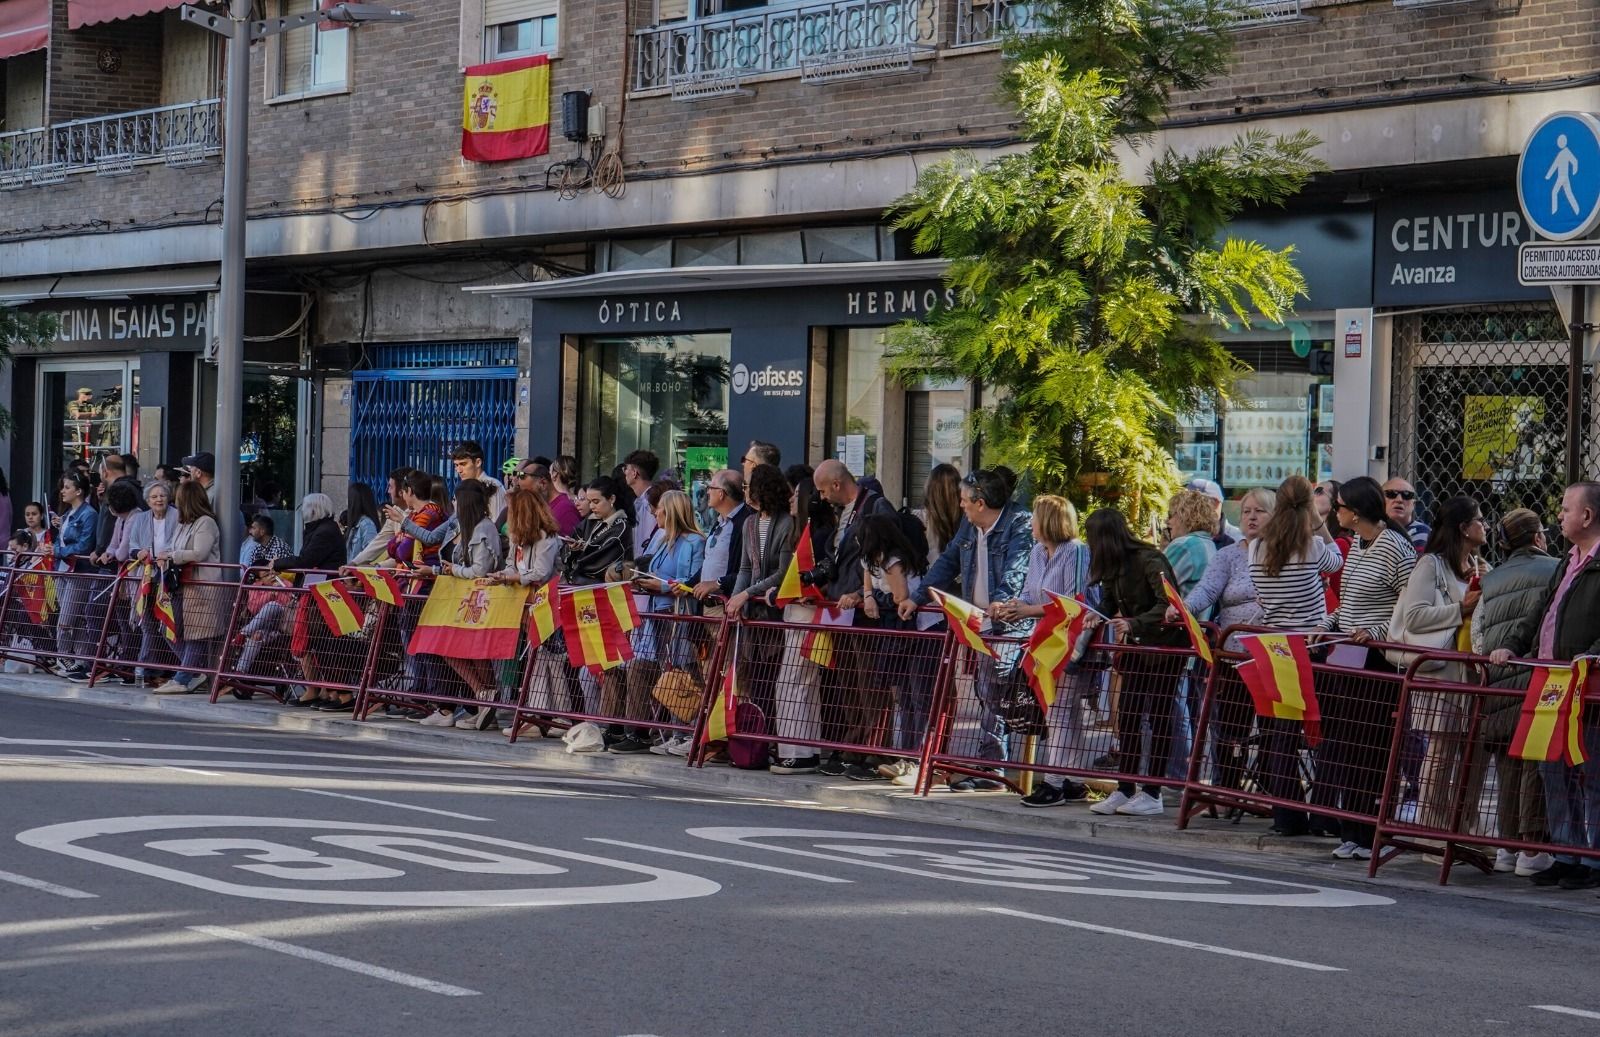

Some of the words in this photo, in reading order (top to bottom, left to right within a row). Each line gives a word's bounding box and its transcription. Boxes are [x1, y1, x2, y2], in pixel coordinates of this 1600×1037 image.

[1391, 211, 1535, 252] CENTUR
[1524, 250, 1565, 262] PERMITIDO
[1566, 249, 1596, 261] ACCESO
[1391, 263, 1456, 285] Avanza
[1524, 266, 1558, 277] COCHERAS
[109, 304, 175, 339] ISAIAS
[599, 300, 681, 323] ÓPTICA
[750, 365, 804, 391] gafas.es
[144, 834, 569, 880] 30
